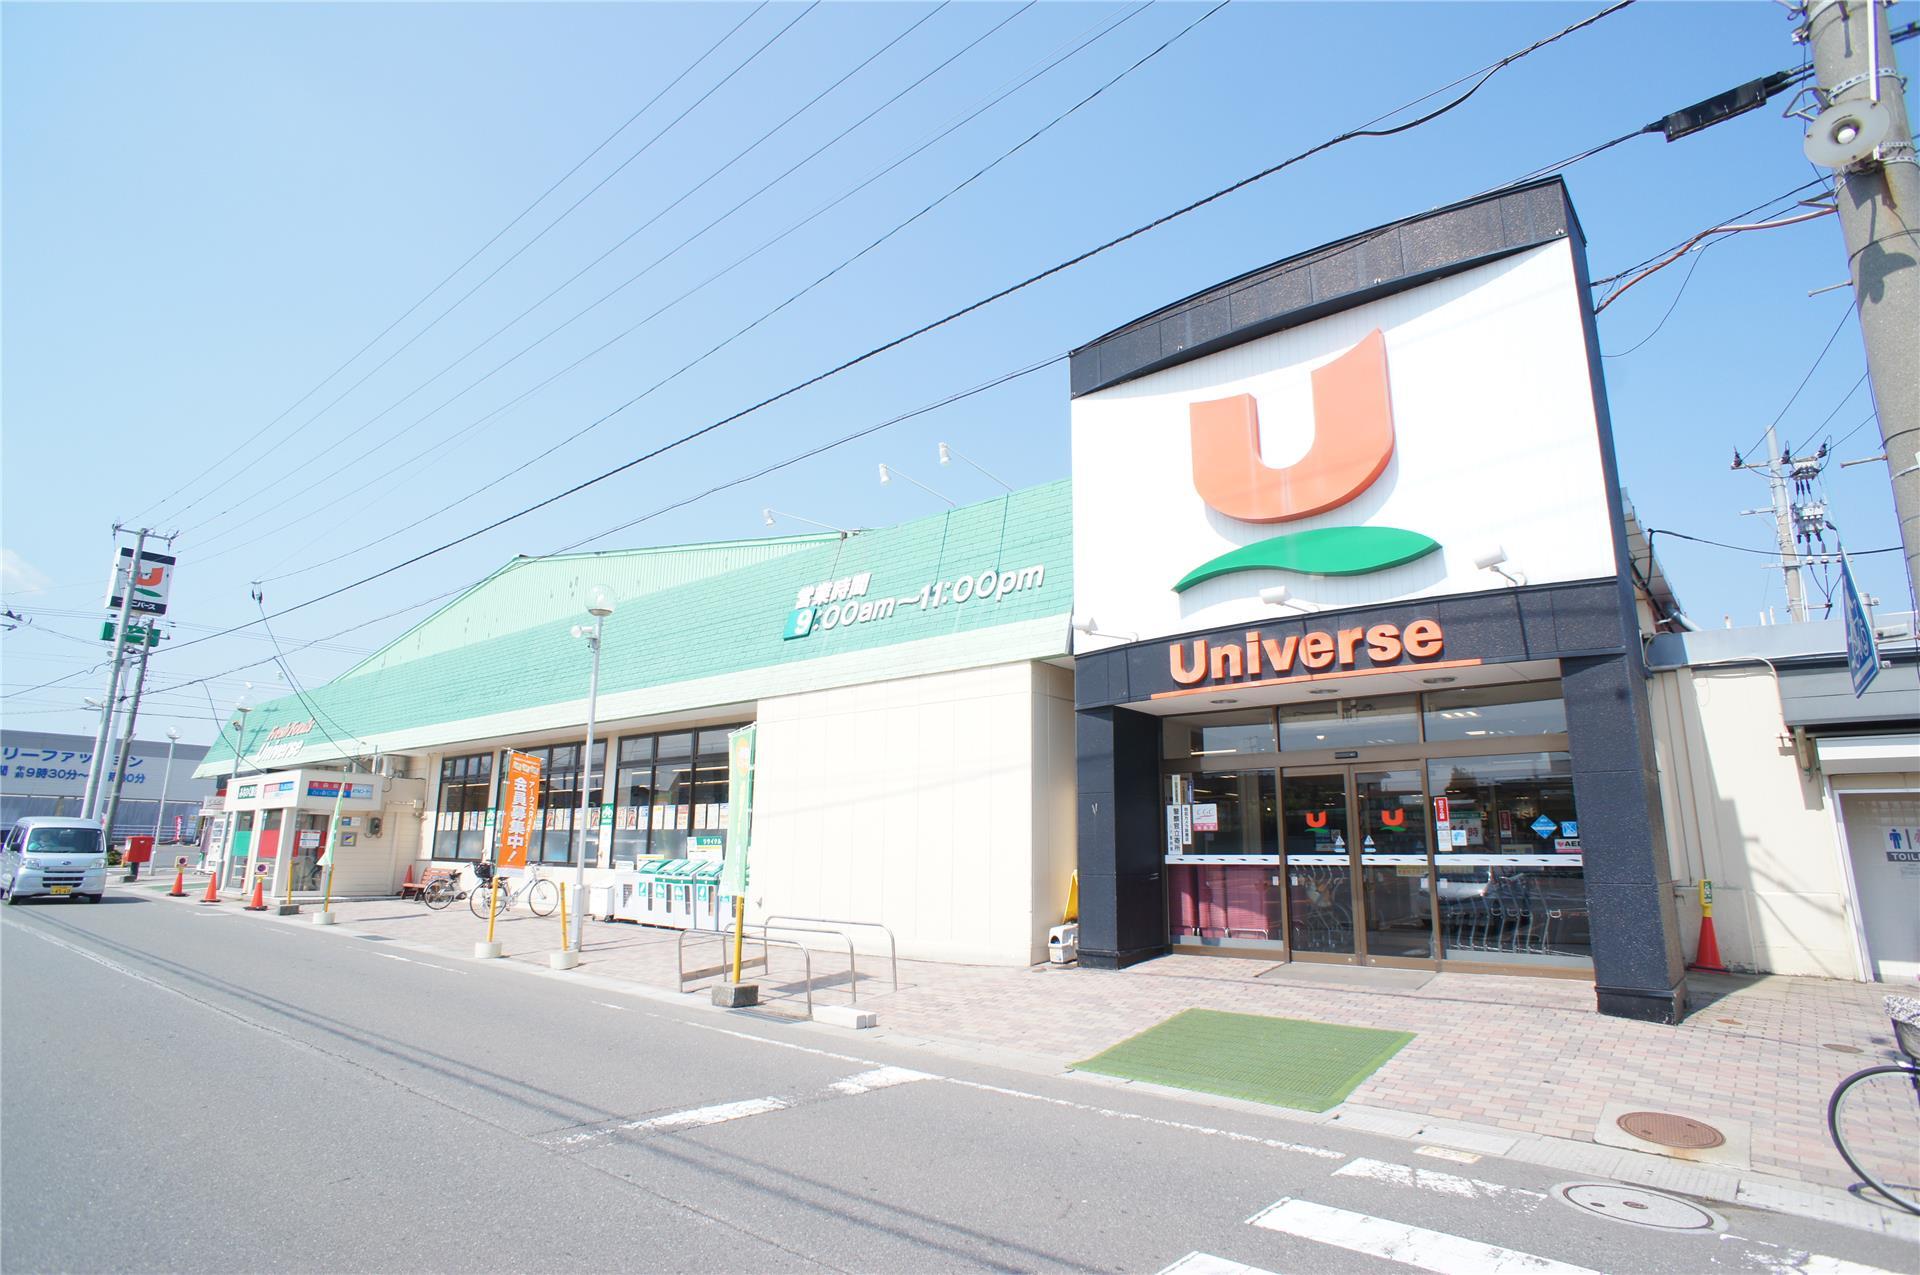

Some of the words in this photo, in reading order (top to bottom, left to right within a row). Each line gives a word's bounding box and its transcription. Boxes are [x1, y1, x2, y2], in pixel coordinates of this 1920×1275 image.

[795, 571, 872, 609] 営業時間
[1169, 618, 1444, 685] Universe
